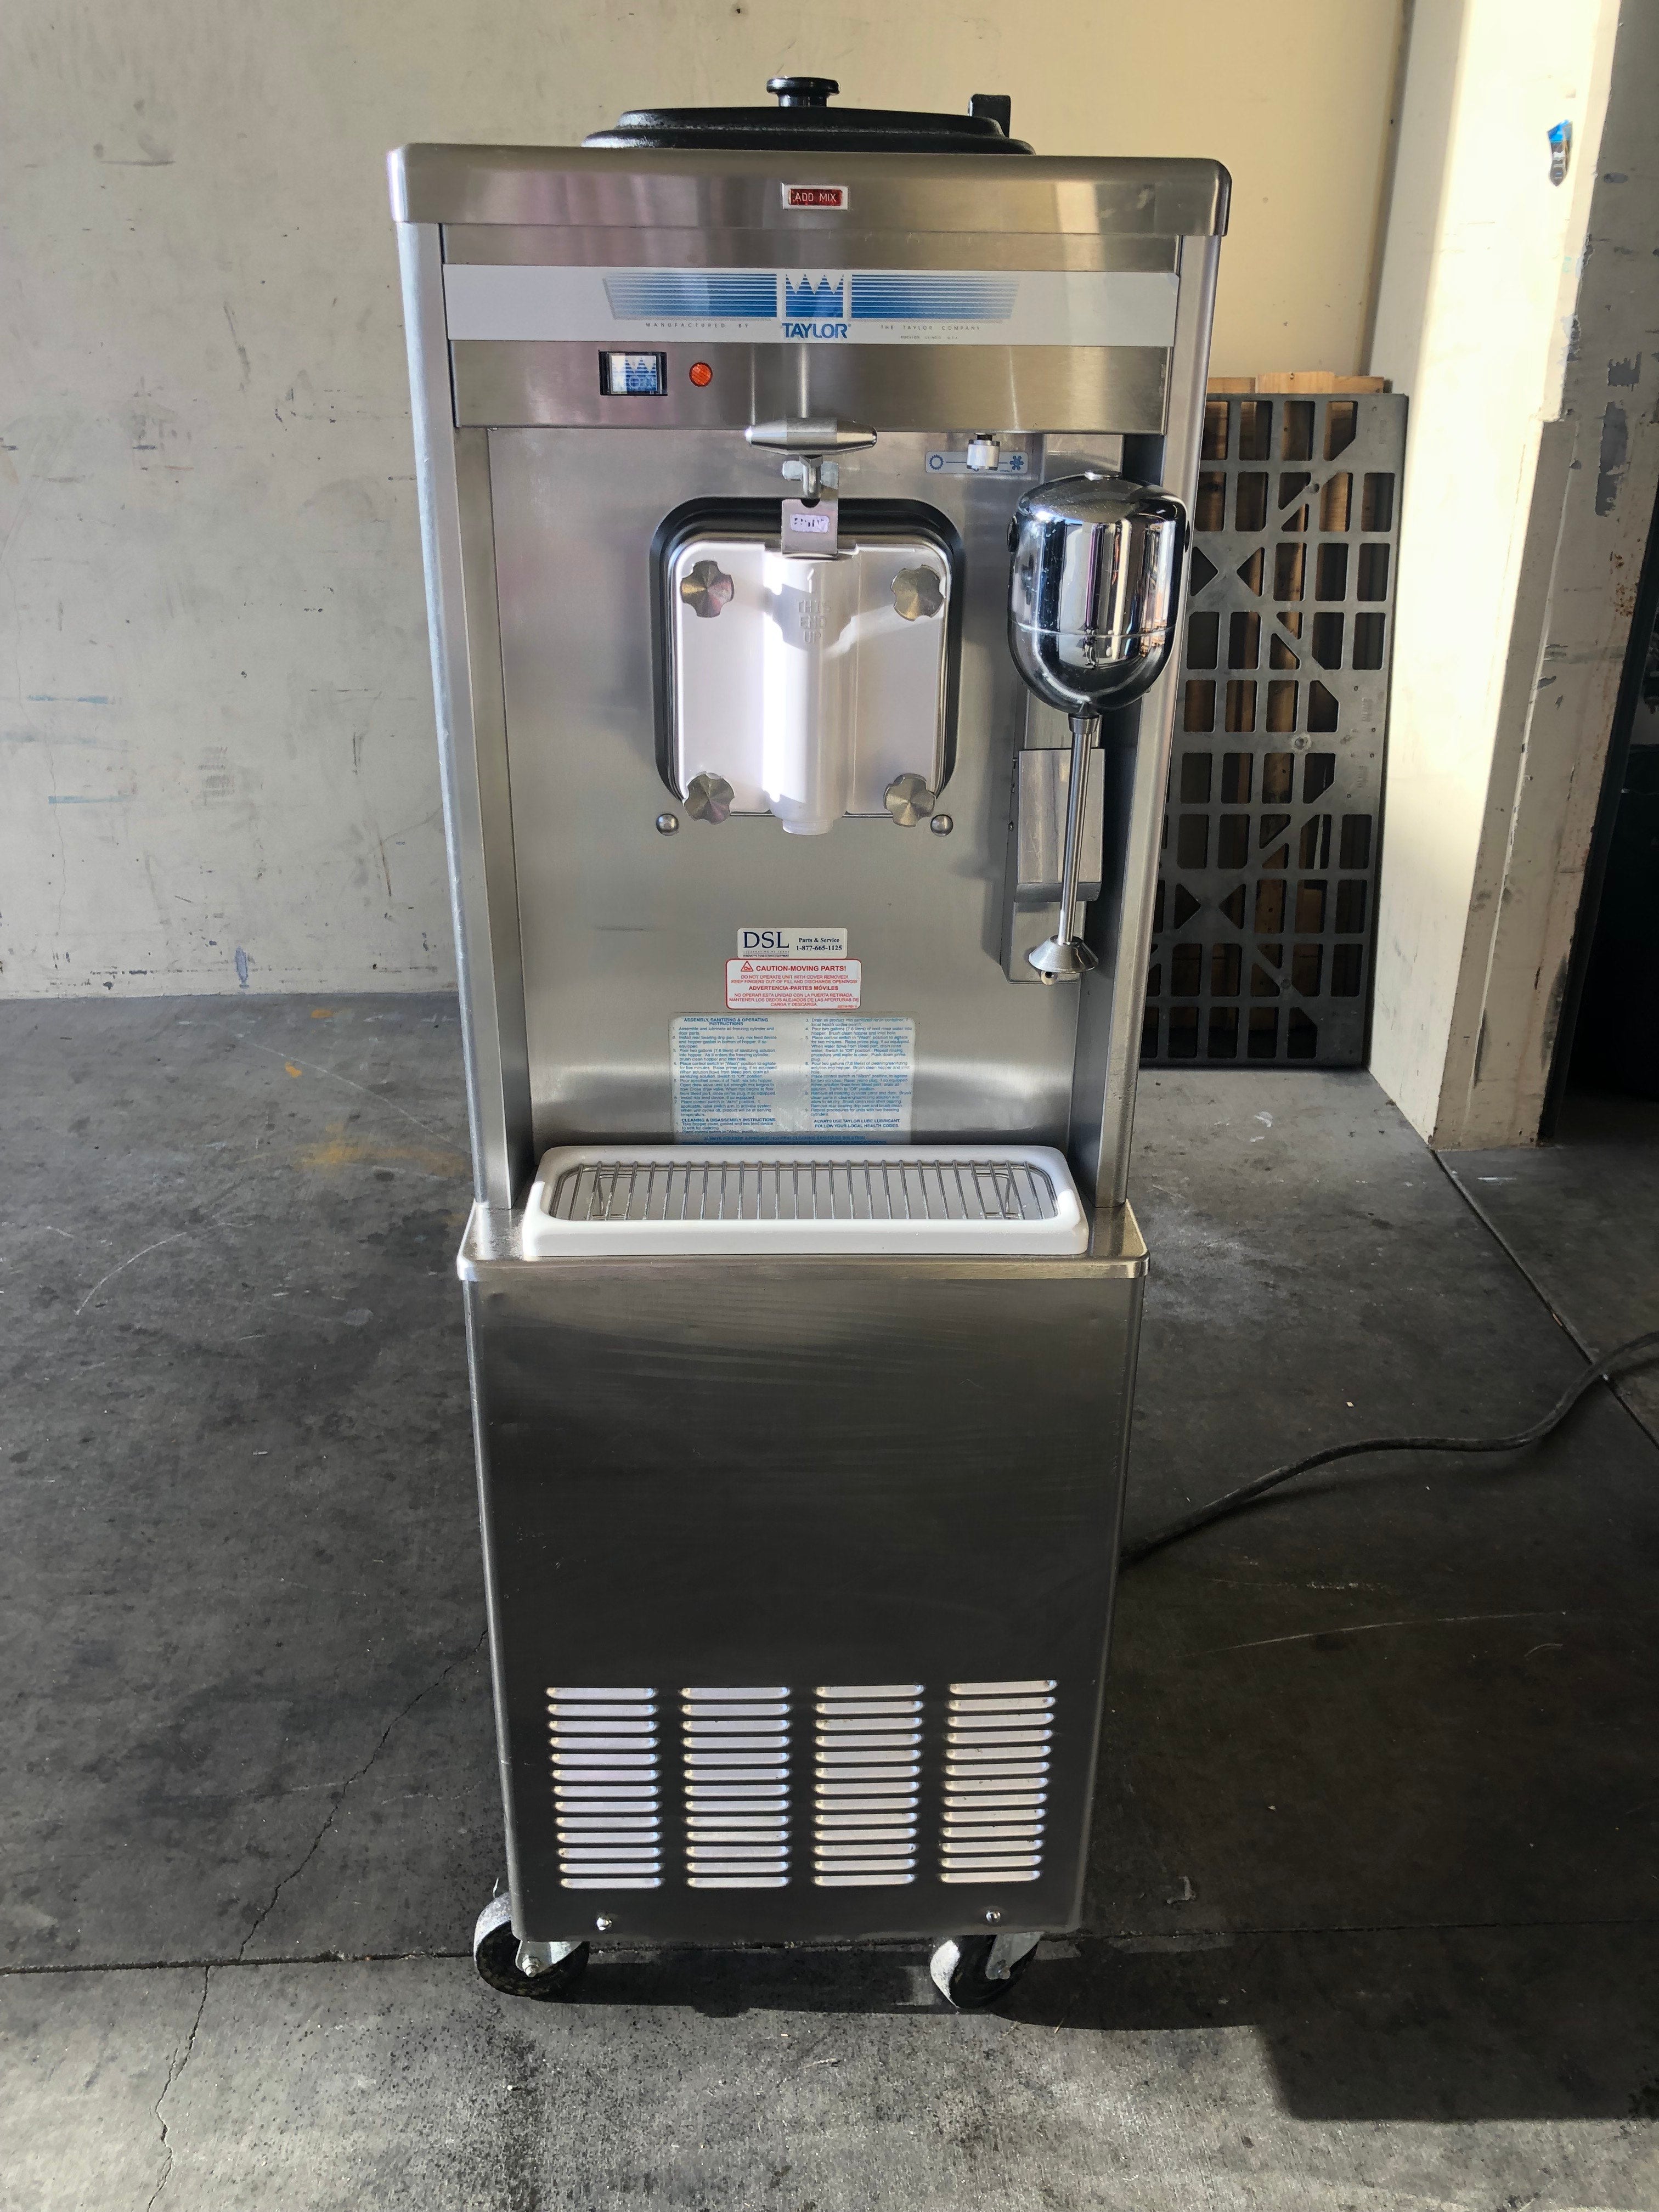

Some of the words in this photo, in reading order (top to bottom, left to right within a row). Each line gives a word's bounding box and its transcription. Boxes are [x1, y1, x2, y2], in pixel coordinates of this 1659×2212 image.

[795, 193, 814, 202] ADD
[820, 193, 837, 202] MIX
[782, 323, 848, 338] TAYLOR
[799, 600, 831, 613] THIS
[799, 616, 827, 629] END
[804, 631, 822, 644] UP
[743, 932, 789, 949] DSL
